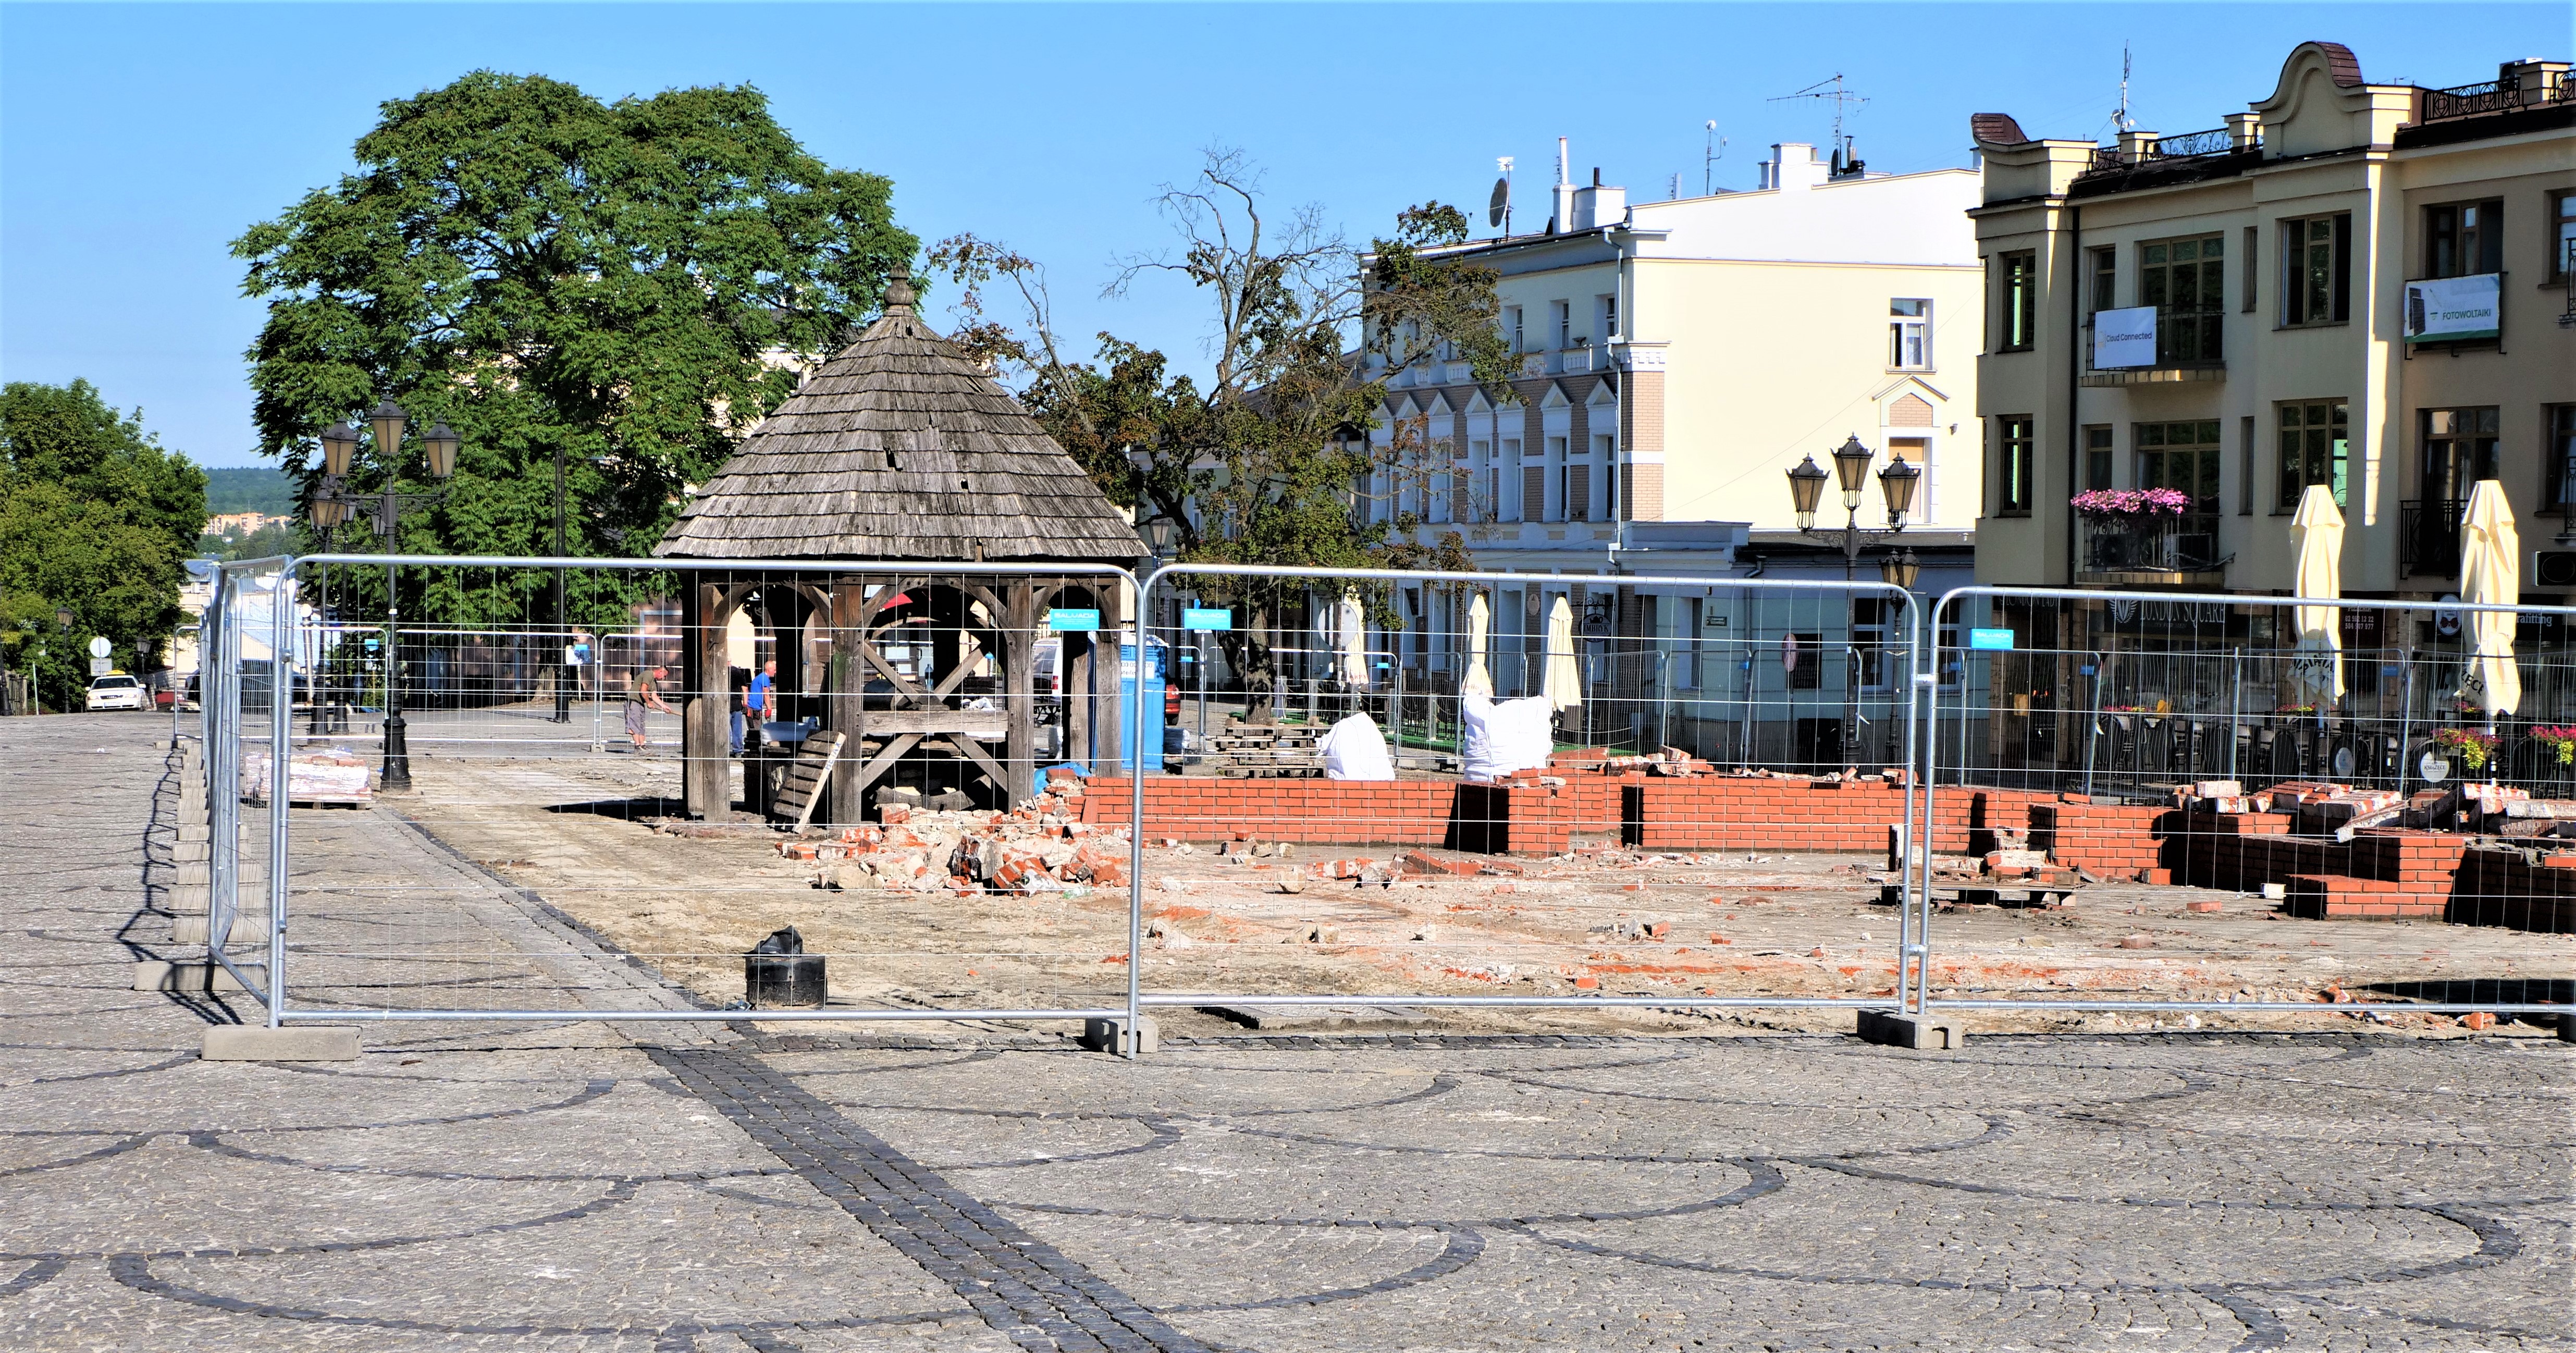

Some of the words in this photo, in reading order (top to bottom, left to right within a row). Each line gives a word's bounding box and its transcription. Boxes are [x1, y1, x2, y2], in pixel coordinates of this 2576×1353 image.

[2443, 309, 2491, 321] FOTOWOLTAIKI
[2121, 331, 2152, 341] Connected
[2140, 601, 2180, 621] LONDON
[2184, 601, 2225, 628] SQUARE
[2517, 612, 2553, 626] rafitting
